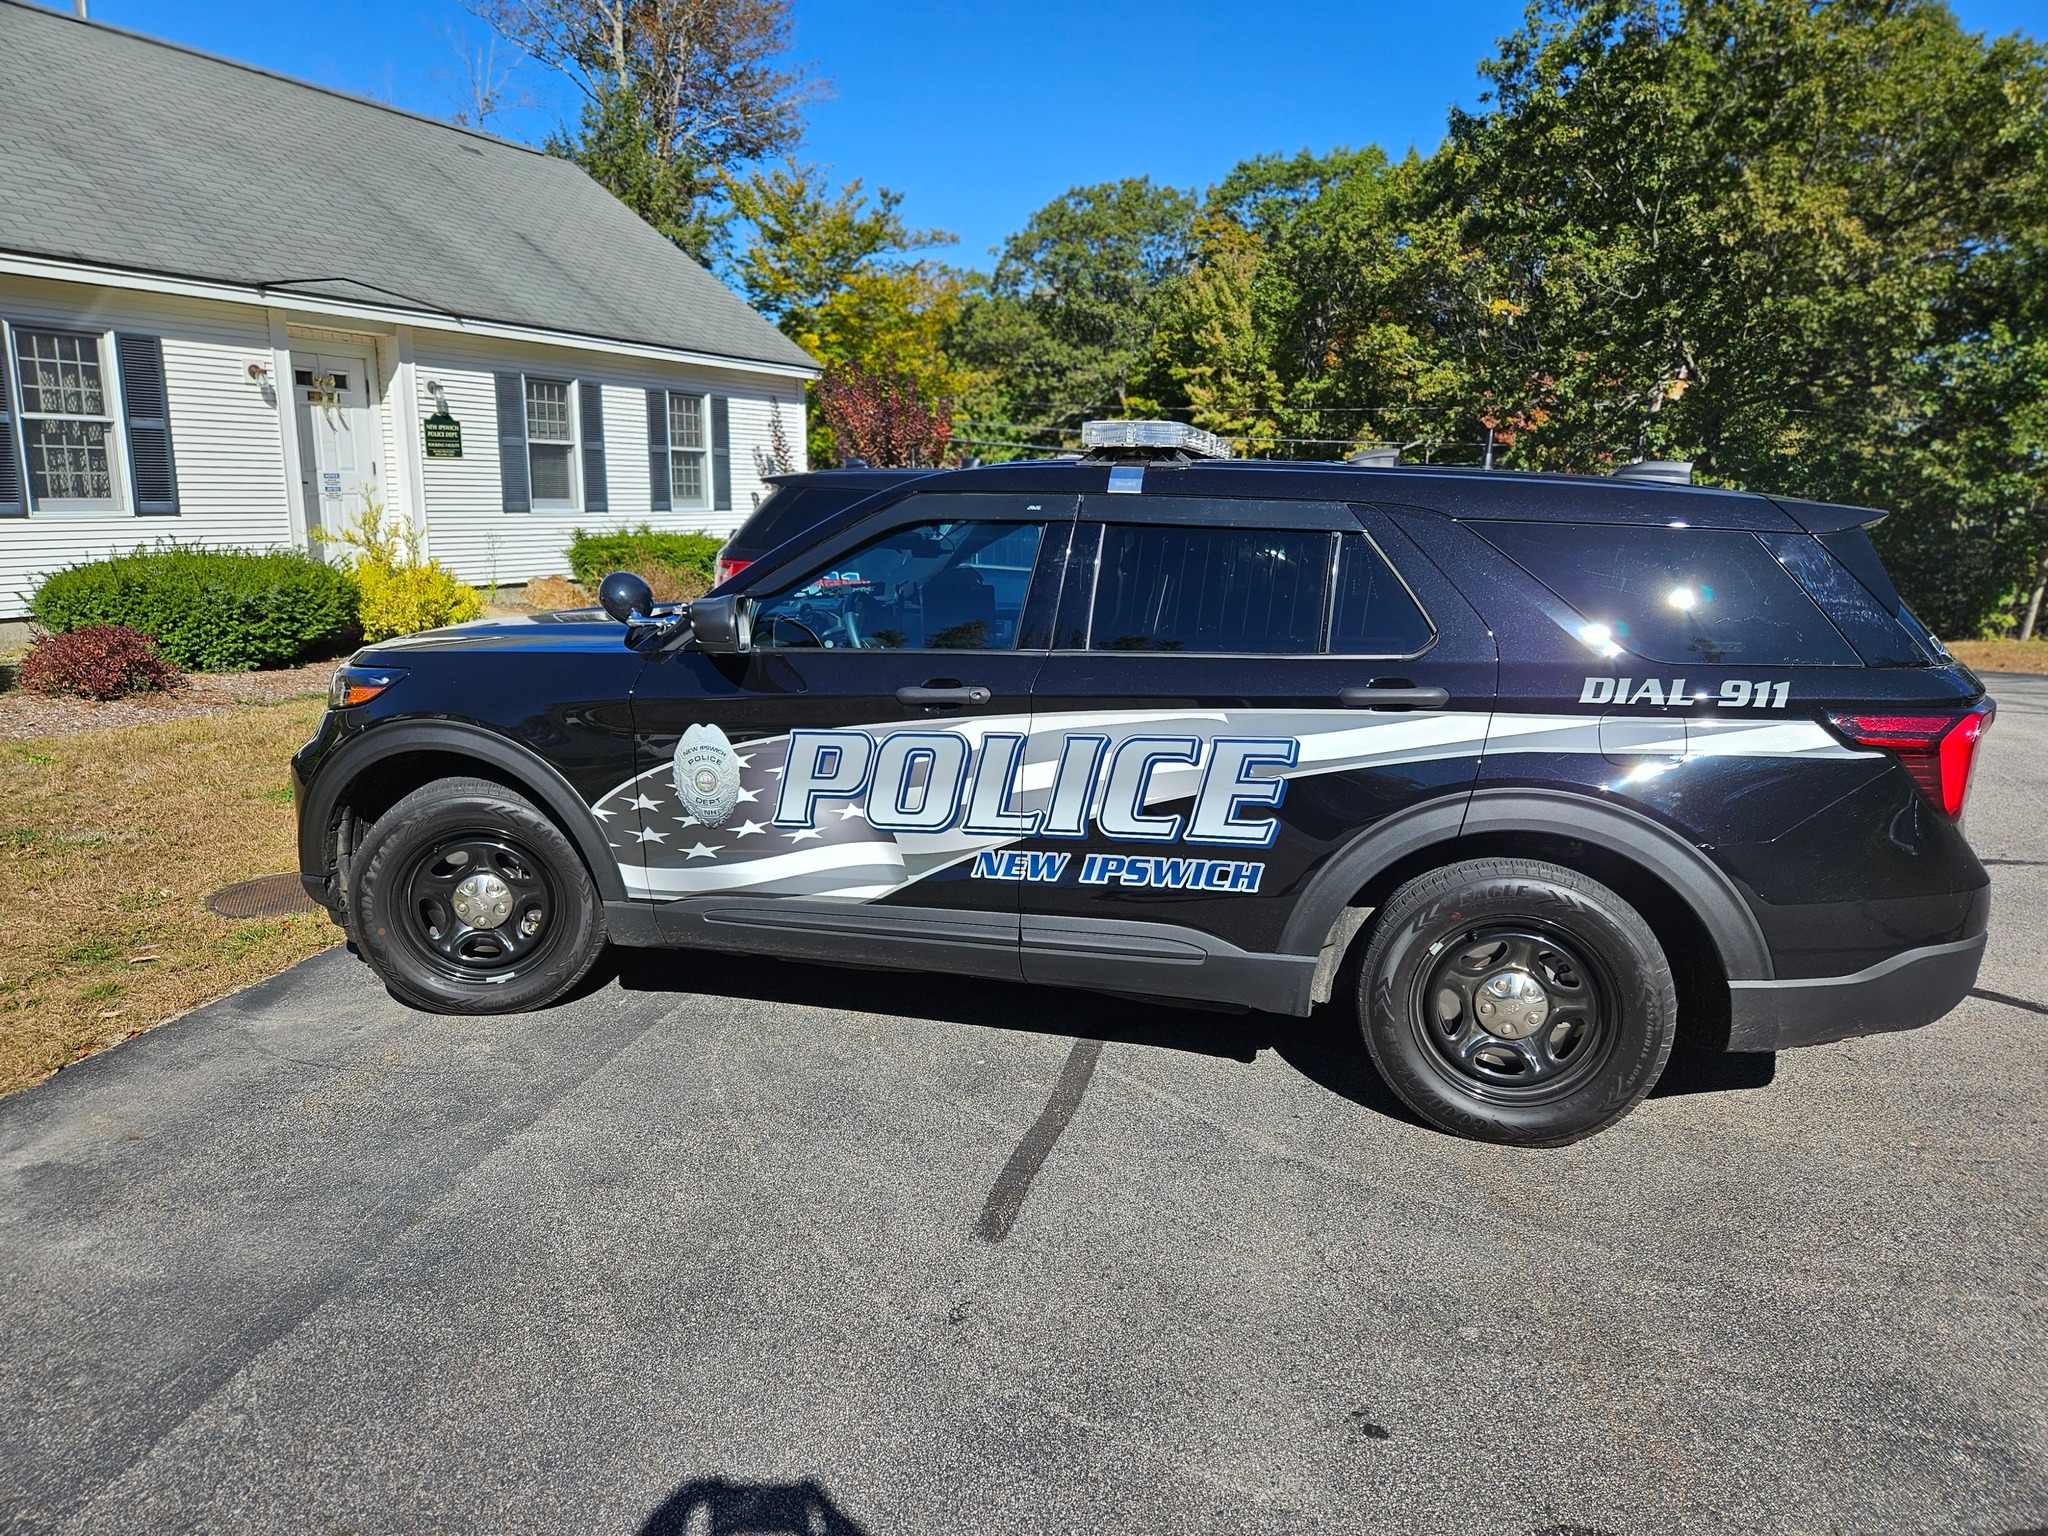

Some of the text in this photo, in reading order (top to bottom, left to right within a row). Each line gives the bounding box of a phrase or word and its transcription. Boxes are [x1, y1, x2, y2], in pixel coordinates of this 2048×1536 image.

[1578, 677, 1791, 709] DIAL 911
[682, 745, 727, 757] NEW IPSWICH
[687, 755, 723, 766] POLICE
[771, 728, 1300, 849] POLICE
[695, 797, 721, 805] DEPT
[971, 850, 1265, 893] NEW IPSWICH
[1459, 884, 1529, 908] EAGLE
